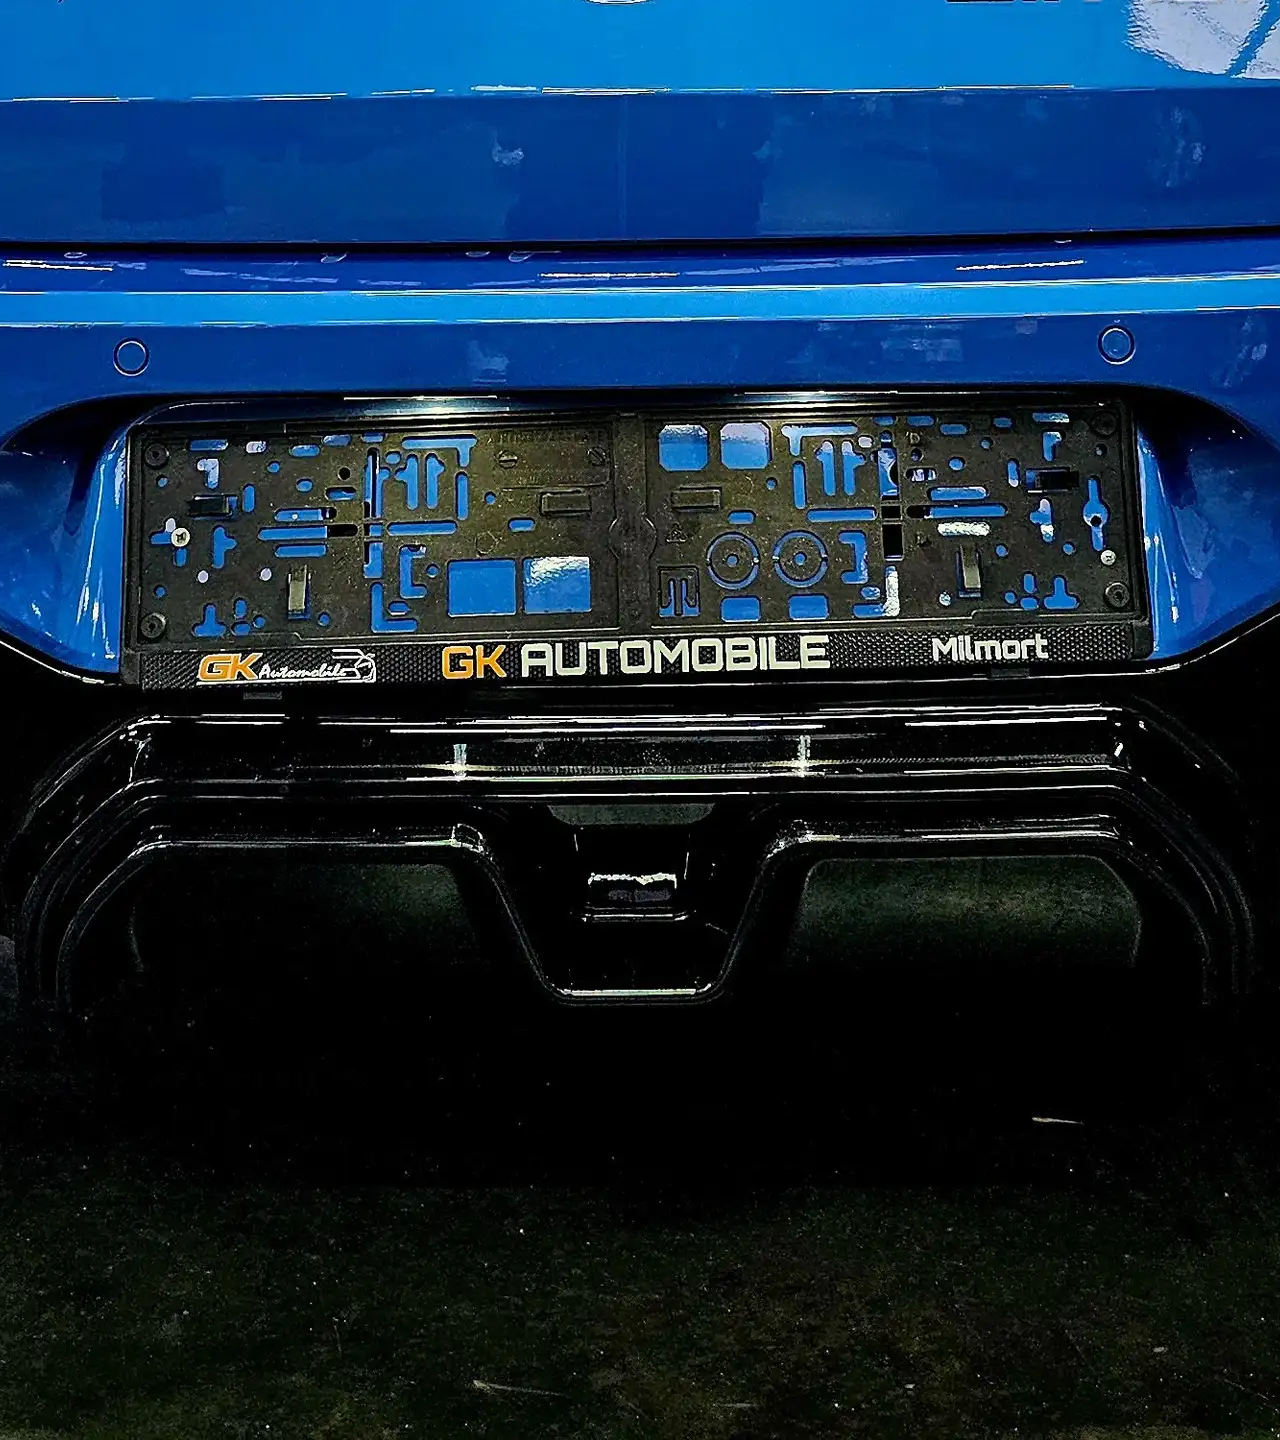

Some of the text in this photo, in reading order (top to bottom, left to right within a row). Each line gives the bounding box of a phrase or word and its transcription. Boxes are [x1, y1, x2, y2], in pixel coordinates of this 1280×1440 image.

[442, 634, 830, 680] GK AUTOMOBILE
[931, 633, 1049, 661] Milmort
[198, 653, 347, 681] GK Automobile
